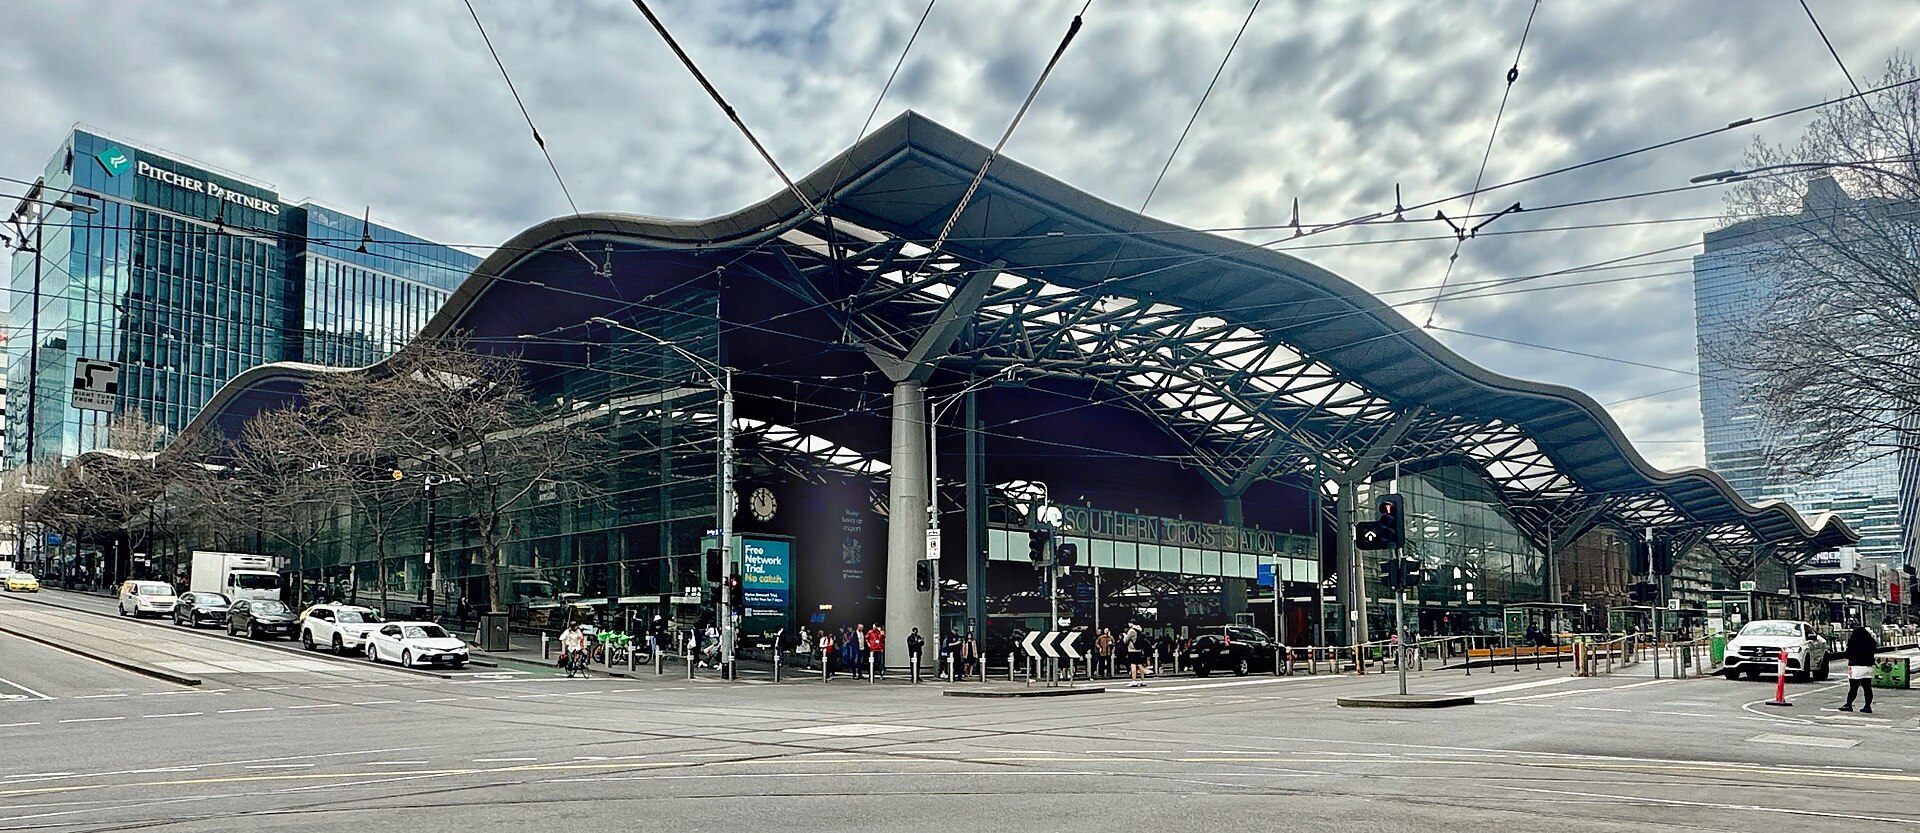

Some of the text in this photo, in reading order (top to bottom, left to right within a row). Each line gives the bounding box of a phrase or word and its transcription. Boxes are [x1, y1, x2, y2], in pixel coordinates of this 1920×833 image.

[138, 160, 280, 216] PITCHER PARTNERS
[1063, 508, 1276, 552] SOUTHERN CROSS STATION
[744, 544, 764, 555] Free
[745, 554, 782, 565] Network
[745, 564, 765, 574] Trial.
[744, 573, 785, 584] No catch.
